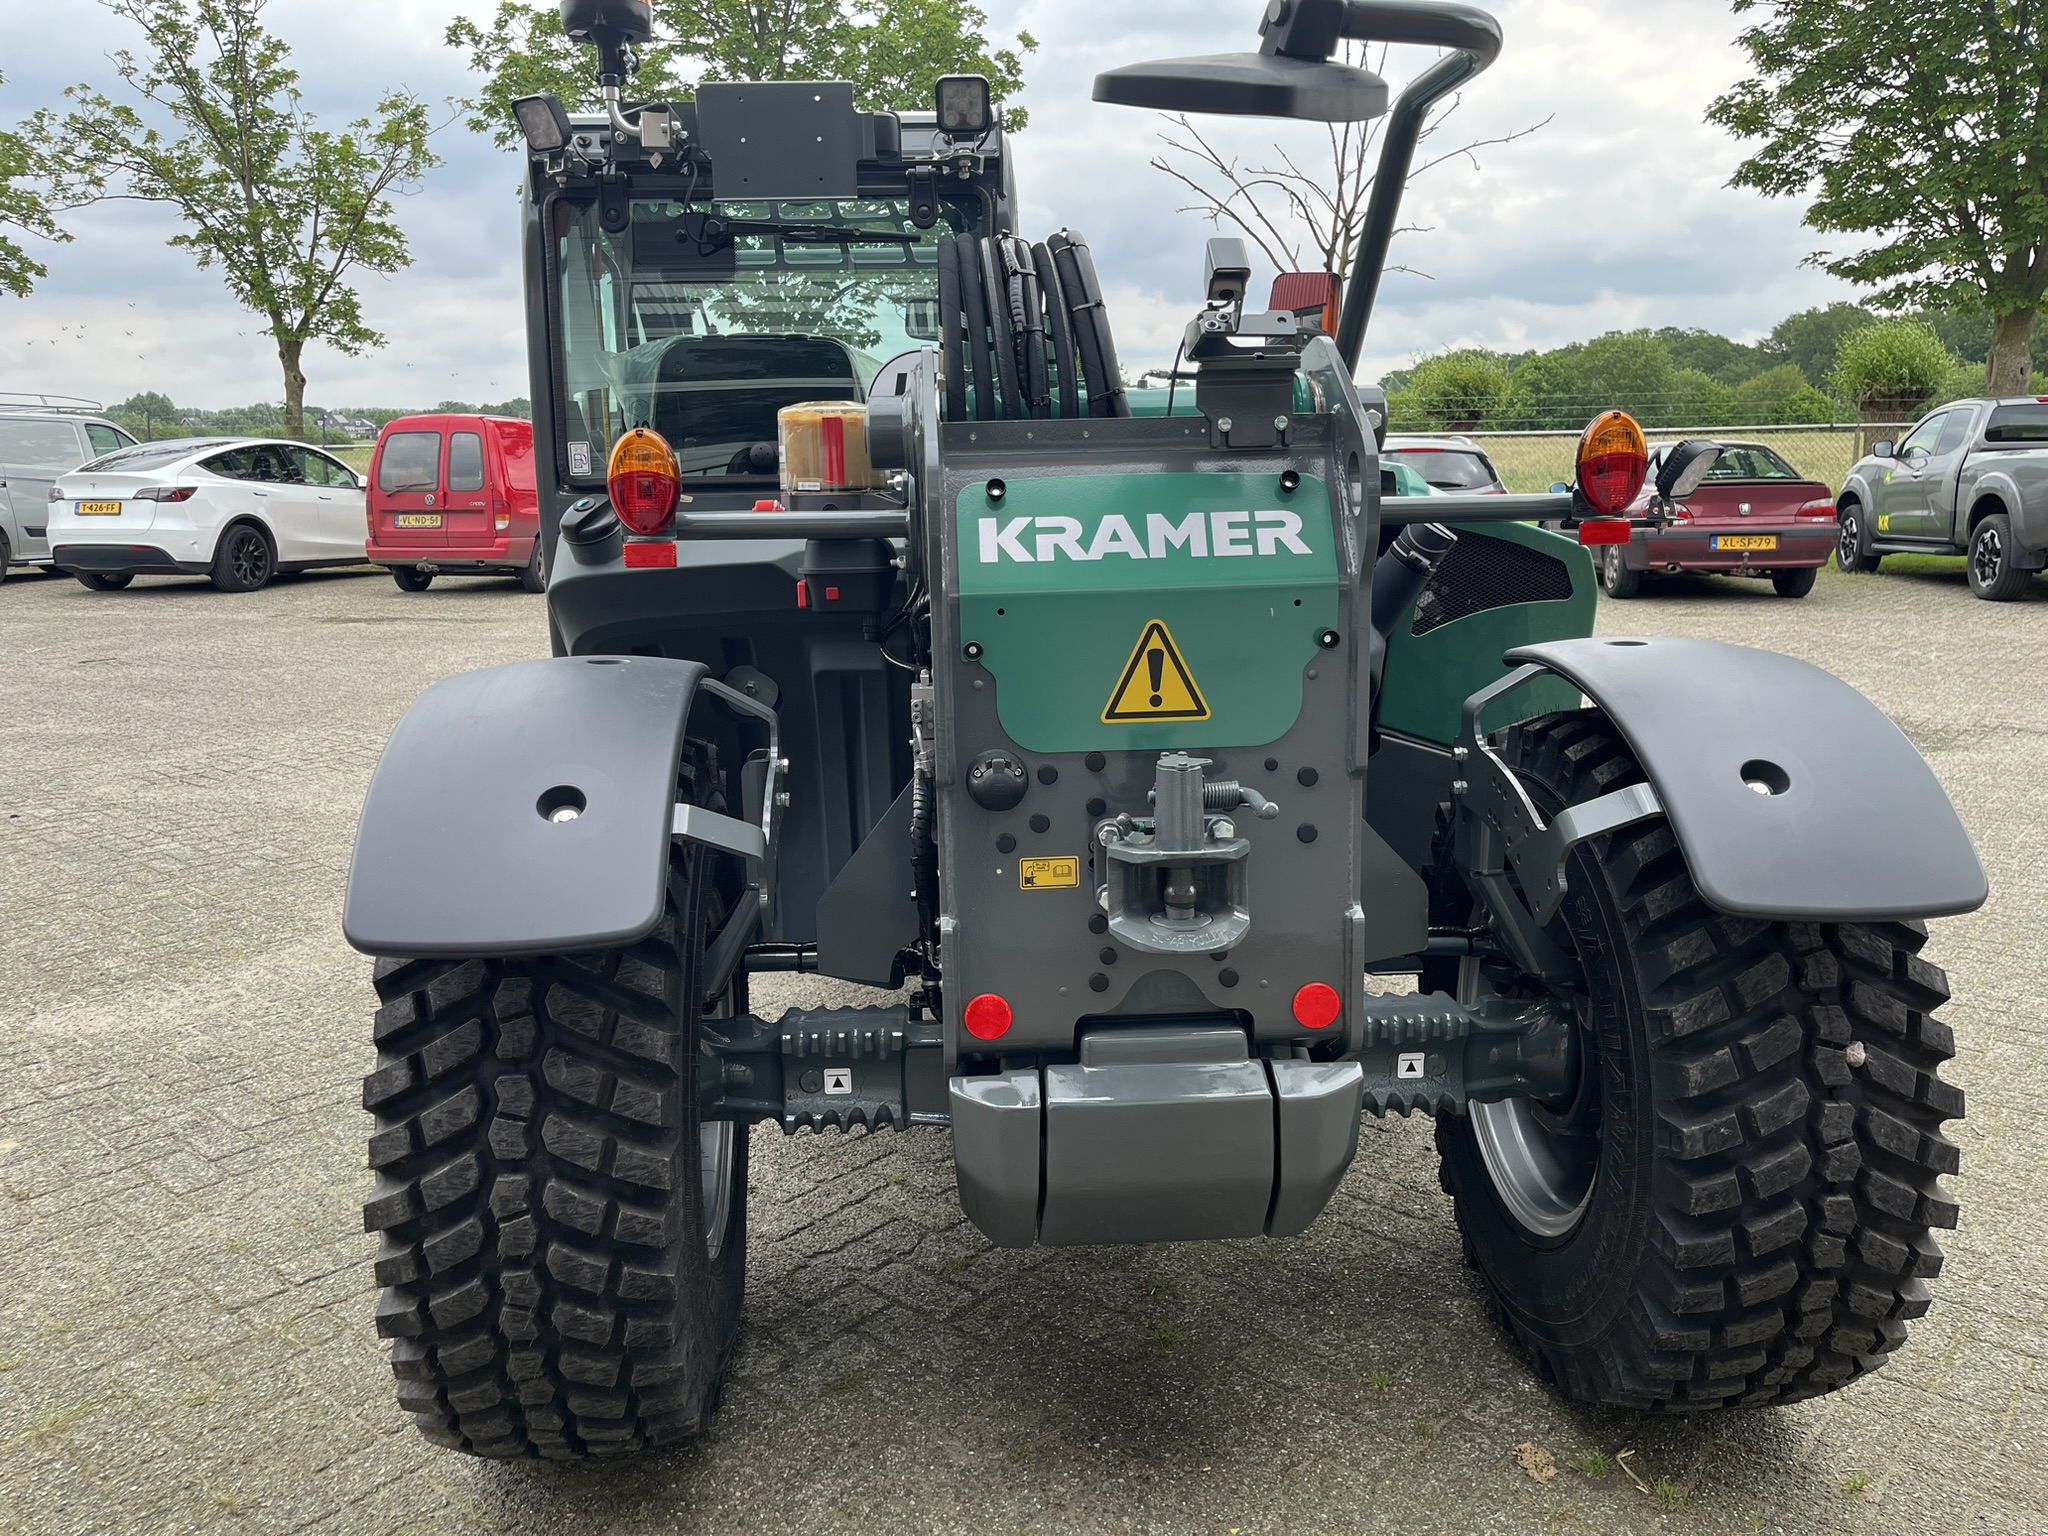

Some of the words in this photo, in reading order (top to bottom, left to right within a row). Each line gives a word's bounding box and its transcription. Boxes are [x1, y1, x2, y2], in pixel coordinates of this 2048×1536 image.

[82, 503, 116, 512] T-426-FF
[978, 510, 1313, 563] KRAMER
[1722, 537, 1771, 547] XL-SF-79
